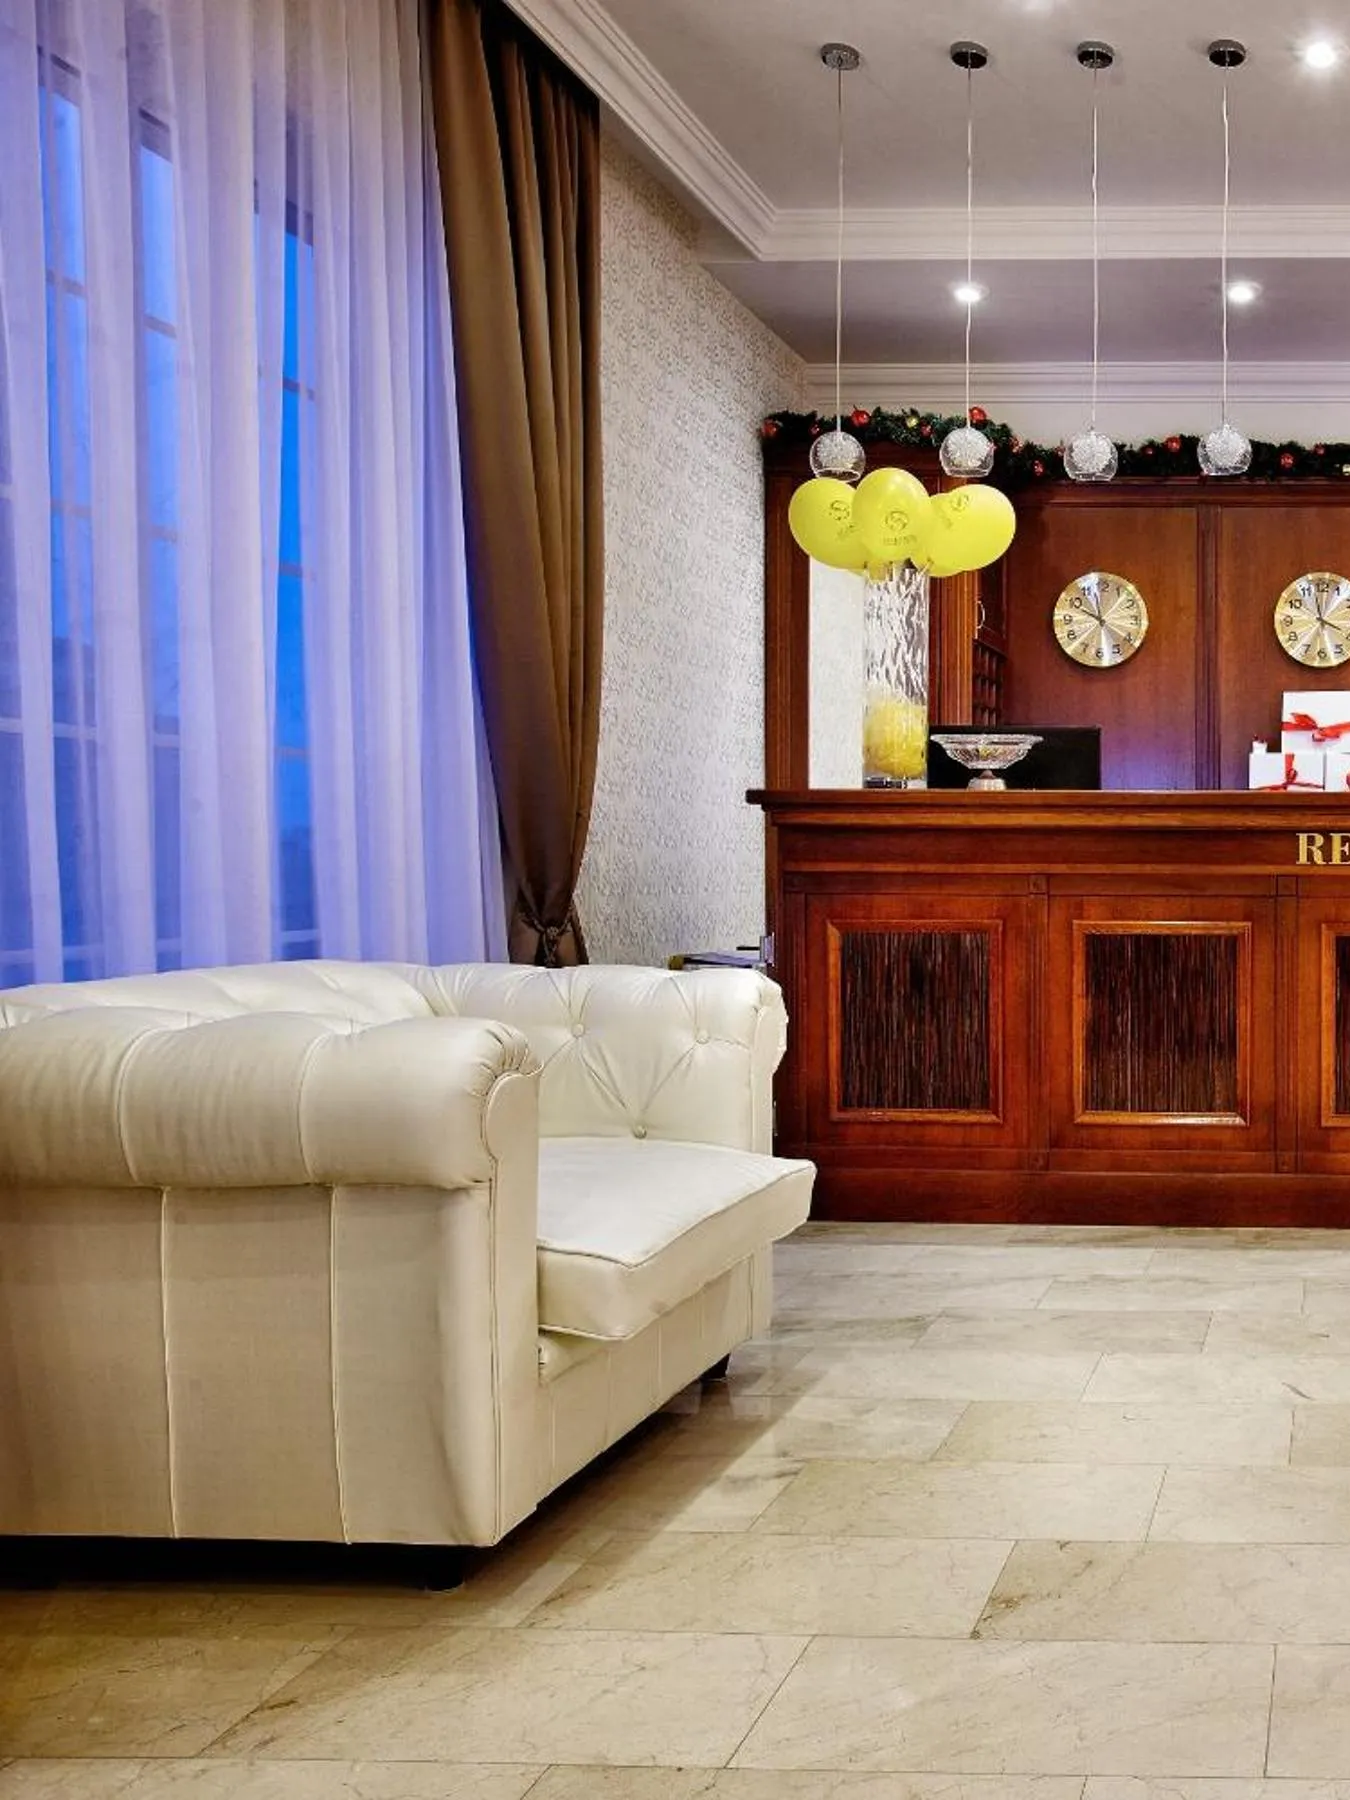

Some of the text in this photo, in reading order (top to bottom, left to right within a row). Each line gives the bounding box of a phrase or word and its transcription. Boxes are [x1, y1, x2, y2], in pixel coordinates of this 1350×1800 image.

[1301, 586, 1311, 597] 11
[1315, 581, 1329, 593] 12
[1069, 597, 1082, 609] 10
[1125, 599, 1135, 609] 2
[1289, 598, 1302, 609] 10
[1063, 614, 1073, 625] 9
[1130, 615, 1138, 626] 3
[1283, 615, 1293, 627] 9
[1289, 632, 1298, 641] 8
[1095, 647, 1104, 659] 6
[1112, 643, 1120, 654] 5
[1302, 644, 1311, 654] 7
[1317, 648, 1327, 659] 6
[1334, 644, 1343, 654] 5
